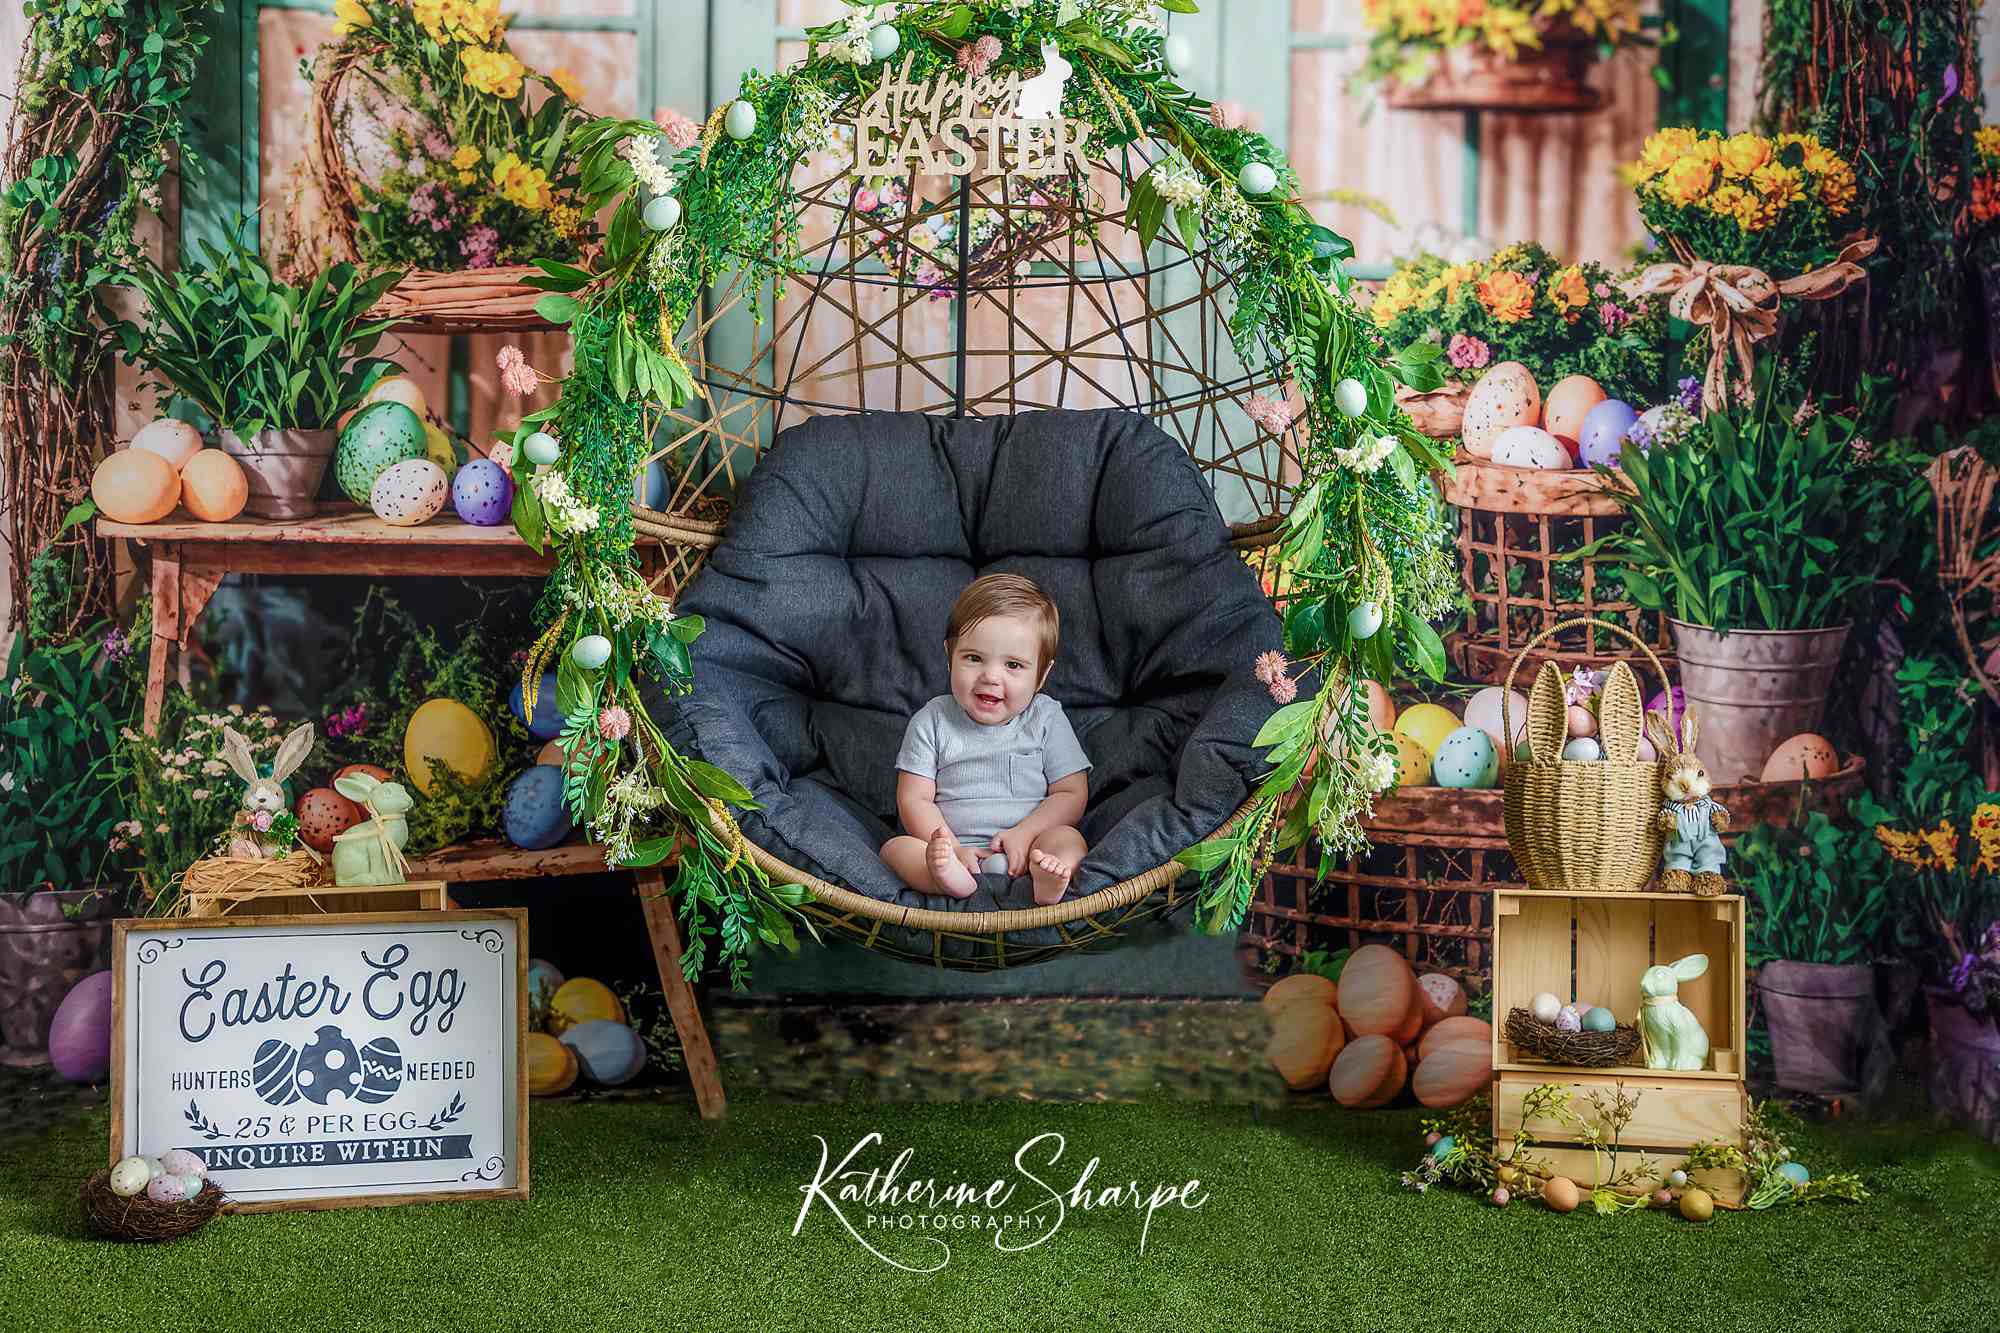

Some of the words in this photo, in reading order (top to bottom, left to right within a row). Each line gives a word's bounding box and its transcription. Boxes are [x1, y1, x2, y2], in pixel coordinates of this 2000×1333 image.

[859, 49, 1019, 139] Happy
[850, 117, 1091, 176] EASTER
[179, 959, 351, 1043] Easter
[360, 943, 466, 1036] Egg
[171, 1070, 251, 1091] HUNTERS
[406, 1060, 475, 1081] NEEDED
[233, 1116, 271, 1139] 25
[306, 1113, 354, 1134] PER
[363, 1111, 417, 1132] EGG
[204, 1144, 326, 1169] INQUIRE
[336, 1138, 444, 1161] WITHIN
